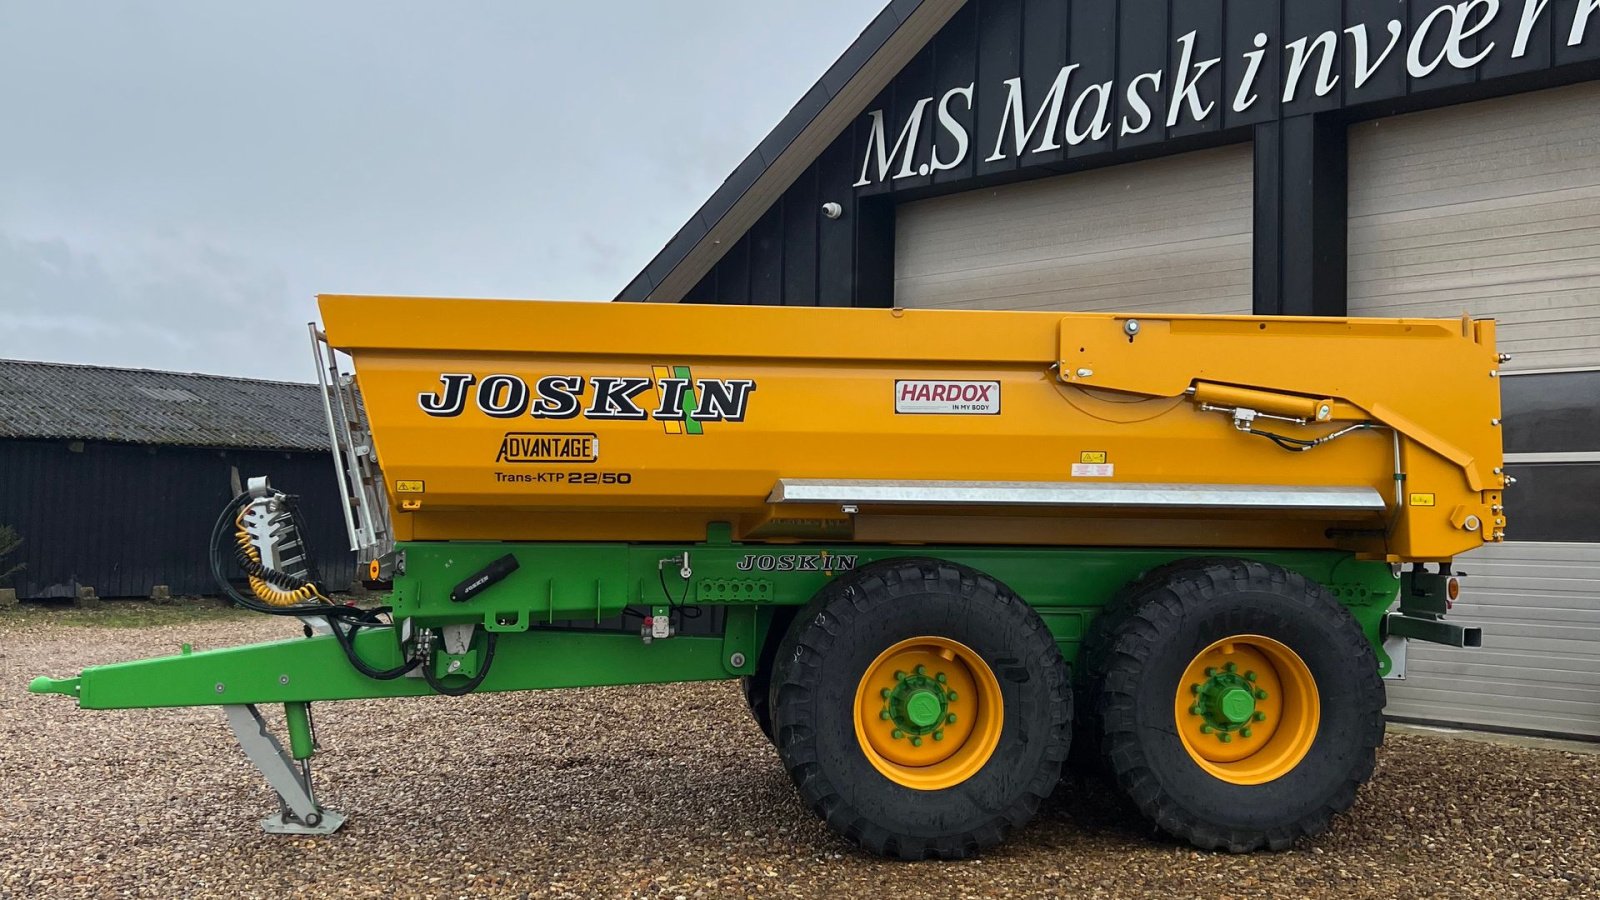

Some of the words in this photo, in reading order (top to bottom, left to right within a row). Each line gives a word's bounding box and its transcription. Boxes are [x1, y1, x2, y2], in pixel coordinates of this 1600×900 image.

[852, 82, 975, 188] M.S
[417, 373, 756, 422] JOSKIN
[495, 438, 591, 463] ADVANTAGE
[494, 471, 565, 483] Trans-KTP
[567, 471, 633, 485] 22/50
[736, 554, 859, 572] JOSKIN
